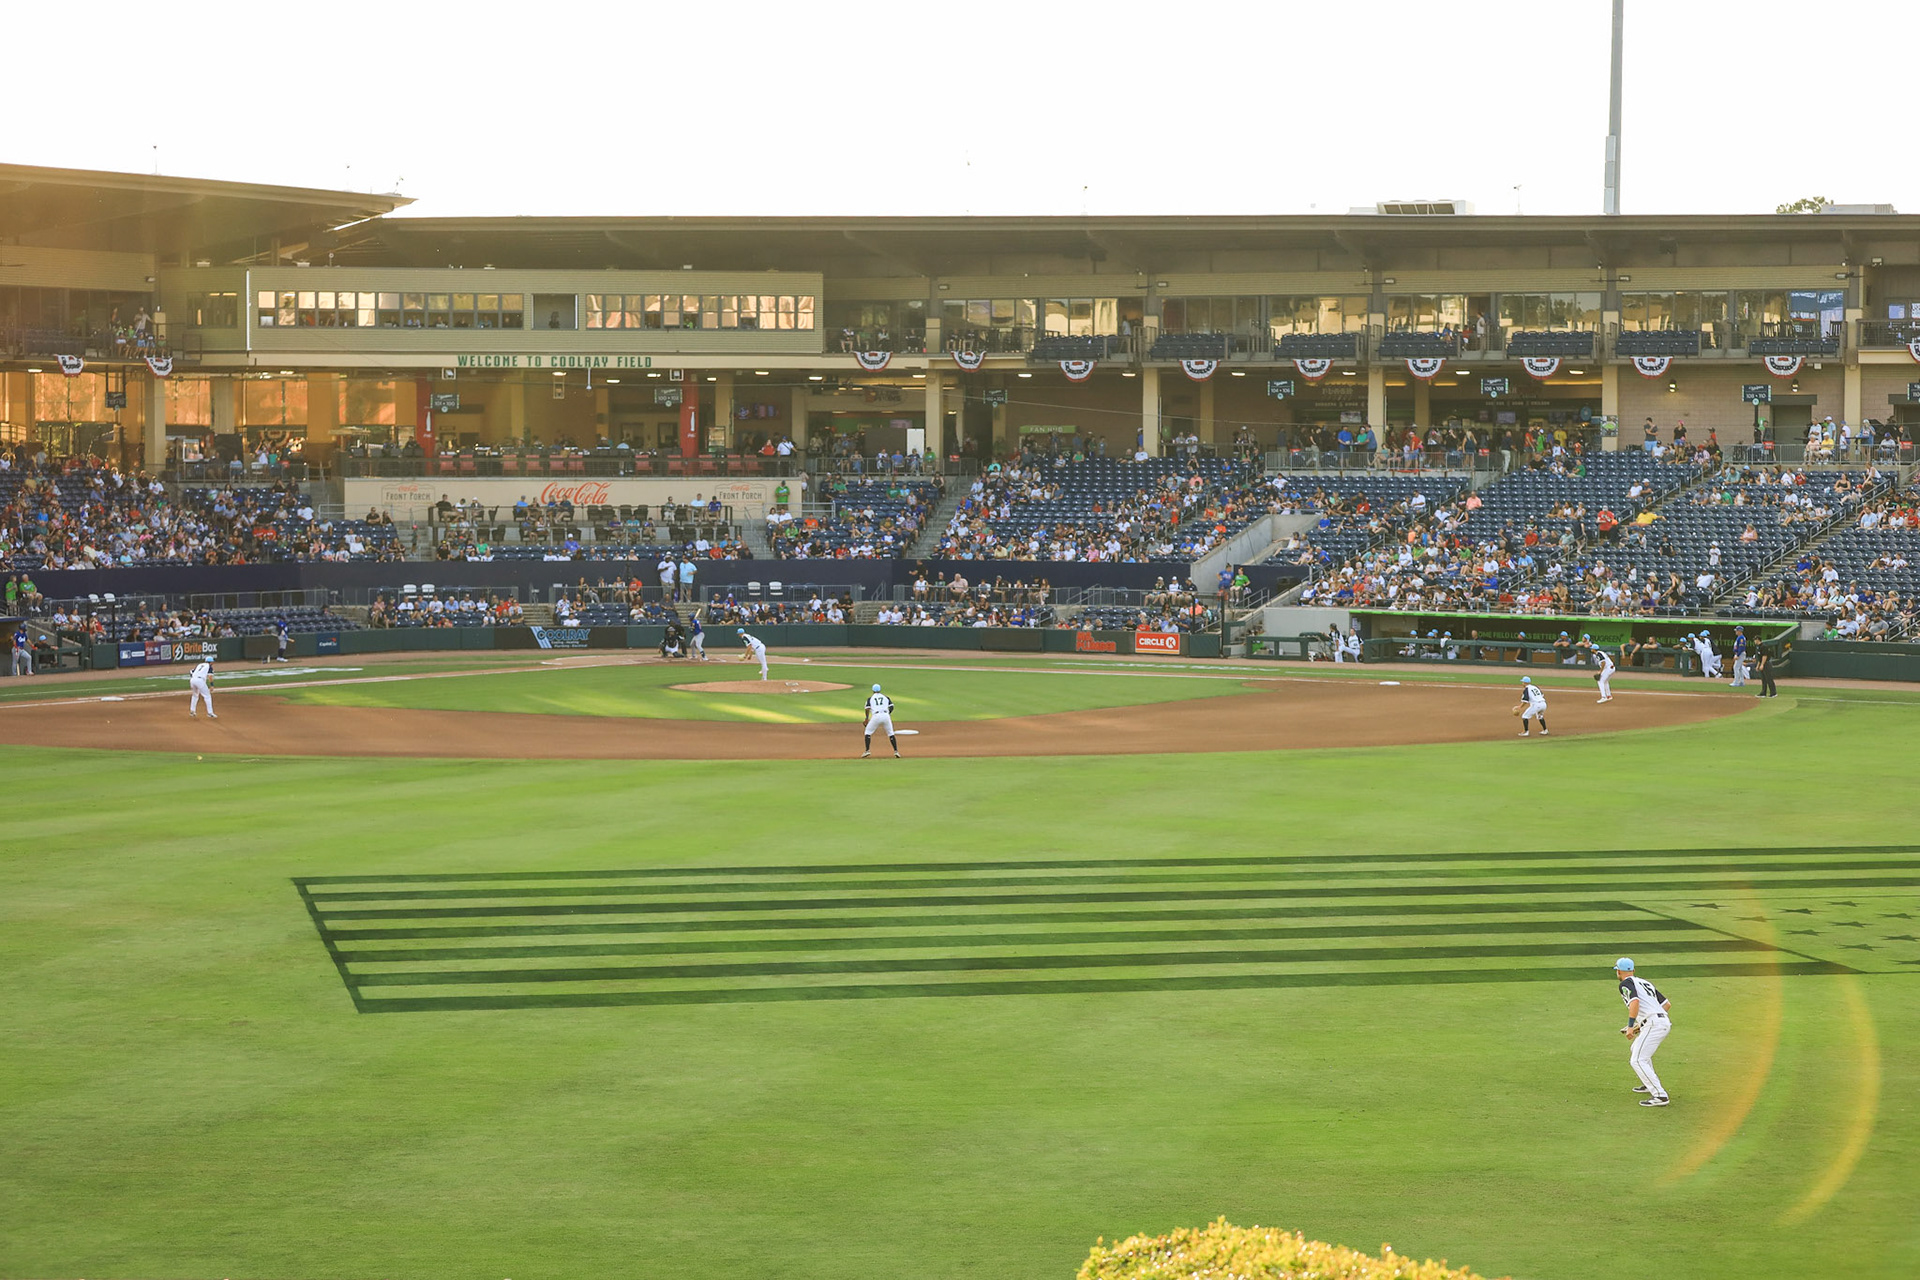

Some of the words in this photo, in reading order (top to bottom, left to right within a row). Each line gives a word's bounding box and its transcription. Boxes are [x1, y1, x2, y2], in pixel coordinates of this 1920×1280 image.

[457, 355, 518, 367] WELCOME
[527, 356, 542, 367] TO
[551, 356, 609, 368] COOLRAY
[617, 356, 652, 368] FIELD
[386, 492, 407, 500] FRONT
[409, 492, 431, 500] PORCH
[541, 481, 613, 505] Coca-Cola
[719, 491, 739, 500] FRONT
[741, 491, 762, 500] PORCH
[537, 628, 591, 641] COOLRAY
[1493, 631, 1509, 639] FIELD
[1511, 631, 1533, 639] LOKS
[1533, 632, 1556, 640] BETTER
[1138, 637, 1165, 646] CIRCLE
[184, 642, 217, 653] BriteBox
[874, 697, 884, 706] 17
